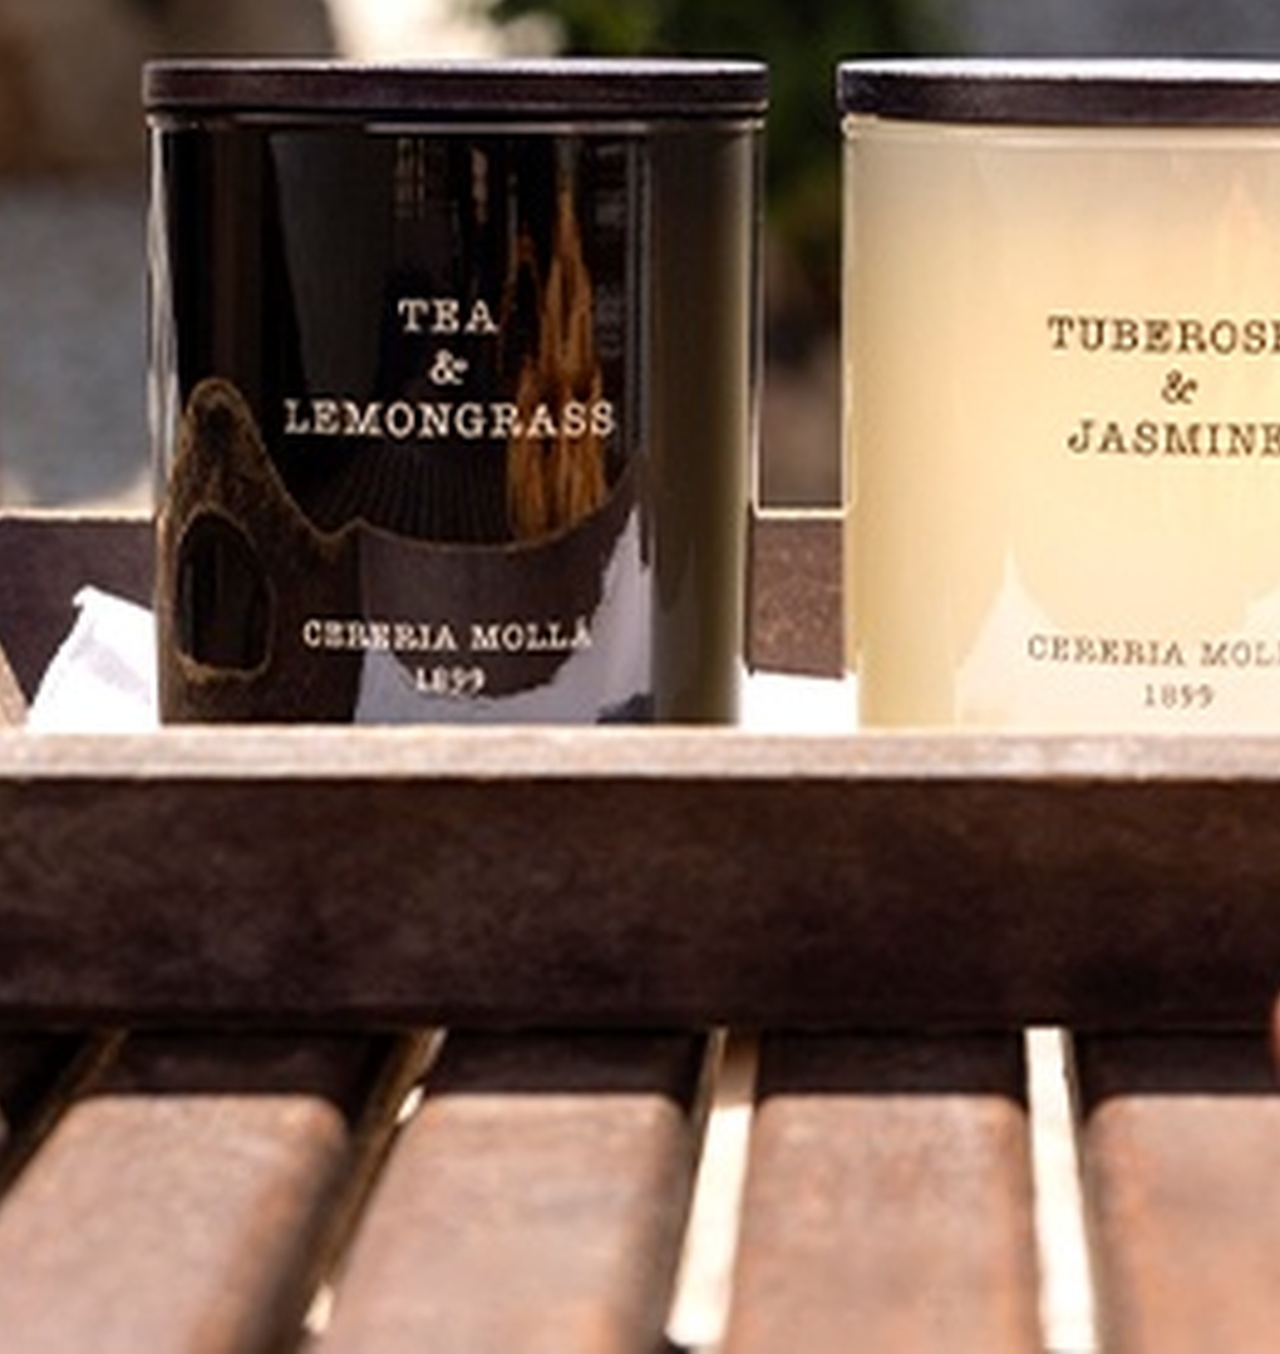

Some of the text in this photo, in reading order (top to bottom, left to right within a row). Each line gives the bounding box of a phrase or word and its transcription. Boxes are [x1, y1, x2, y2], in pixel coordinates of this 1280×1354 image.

[398, 299, 499, 333] TEA
[429, 349, 469, 386] &
[1161, 369, 1199, 405] &
[283, 398, 616, 438] LEMONGRASS
[303, 618, 458, 651] CERERIA
[1027, 634, 1186, 667] CERERIA
